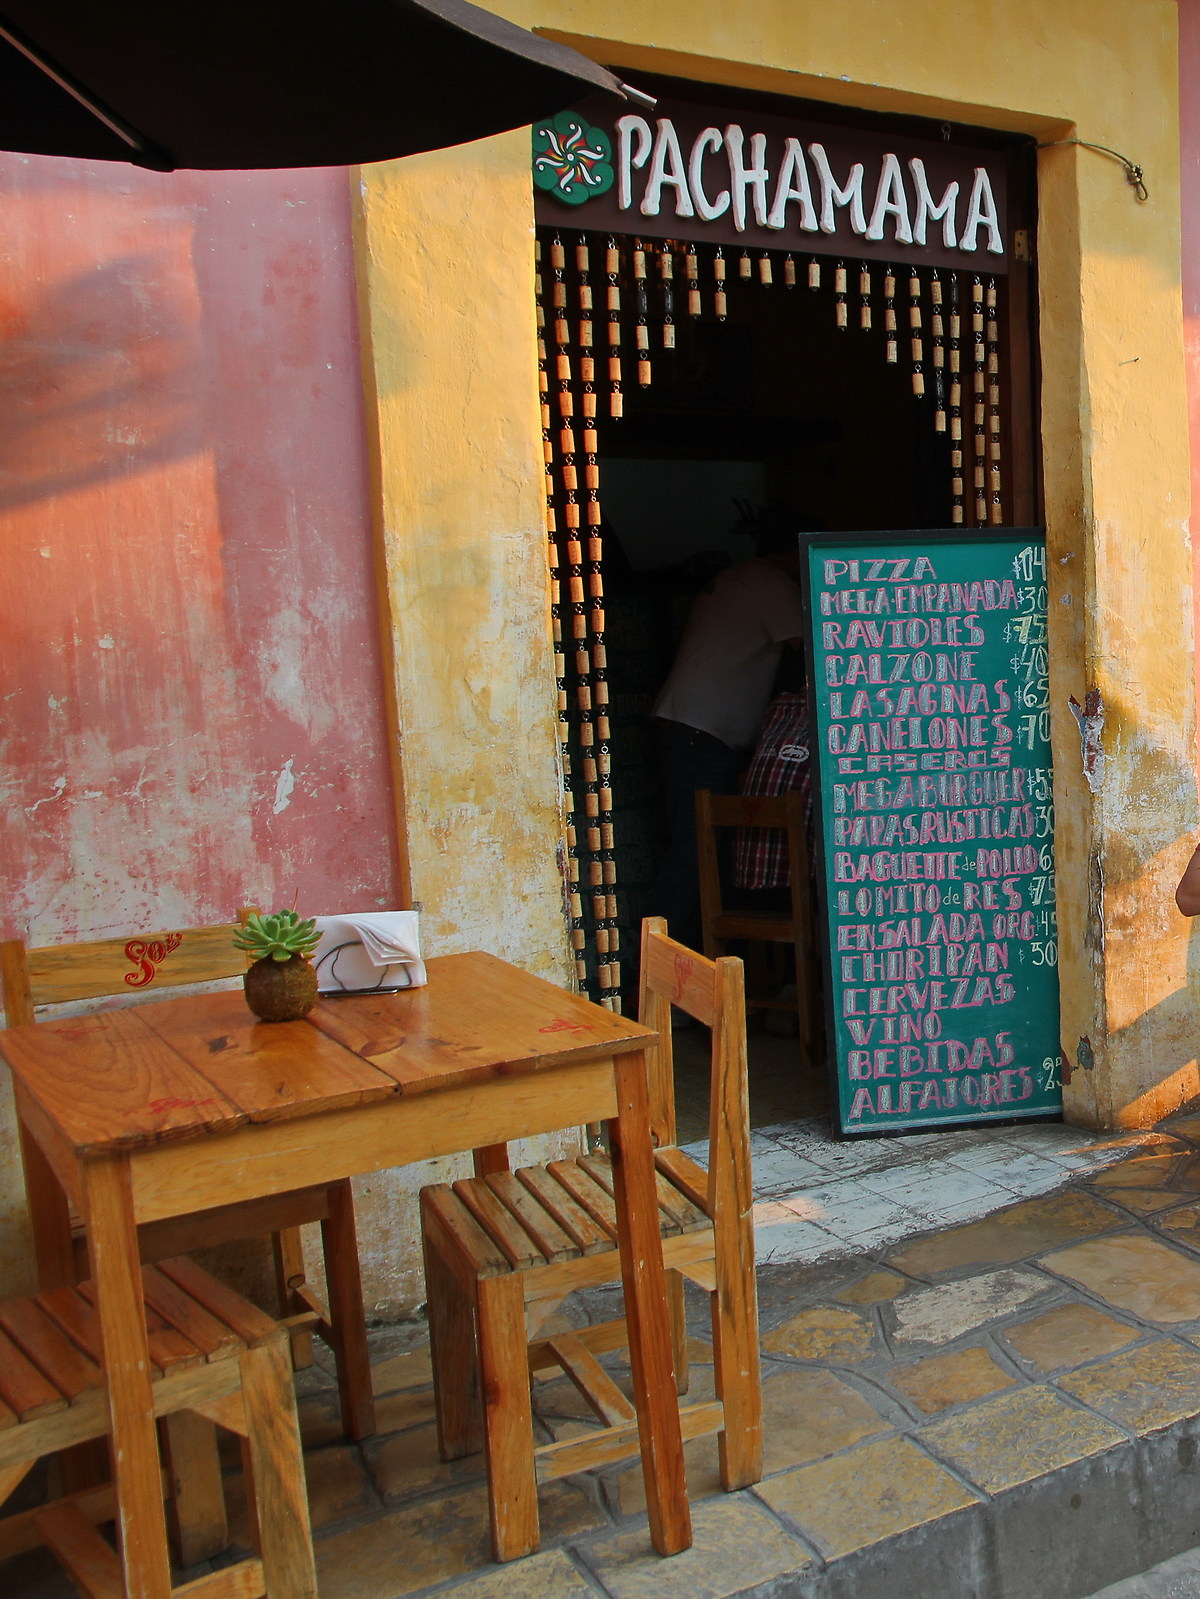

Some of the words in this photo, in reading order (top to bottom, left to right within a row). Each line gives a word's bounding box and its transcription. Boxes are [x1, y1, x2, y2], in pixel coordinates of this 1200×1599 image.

[614, 113, 1004, 255] PACHAMAMA
[824, 557, 938, 584] PIZZA
[822, 614, 985, 650] RAVIOLES
[825, 651, 979, 687] CALZONE
[830, 679, 1011, 719] LASAGNAS
[828, 714, 1013, 754] CANELONES
[838, 746, 1012, 774] CASEROS
[834, 850, 963, 883] BAGUETTE
[962, 856, 977, 872] de
[976, 844, 1039, 878] POLLO
[838, 882, 942, 917] LOMITO
[943, 886, 961, 906] de
[963, 877, 1022, 911] RES
[838, 913, 986, 951] ENSALADA
[841, 942, 1008, 982] CHORIPAN
[844, 973, 1015, 1018] CERVEZAS
[844, 1011, 942, 1045] VINO
[848, 1031, 1014, 1081] BEBIDAS
[849, 1066, 1033, 1119] ALFAJORES
